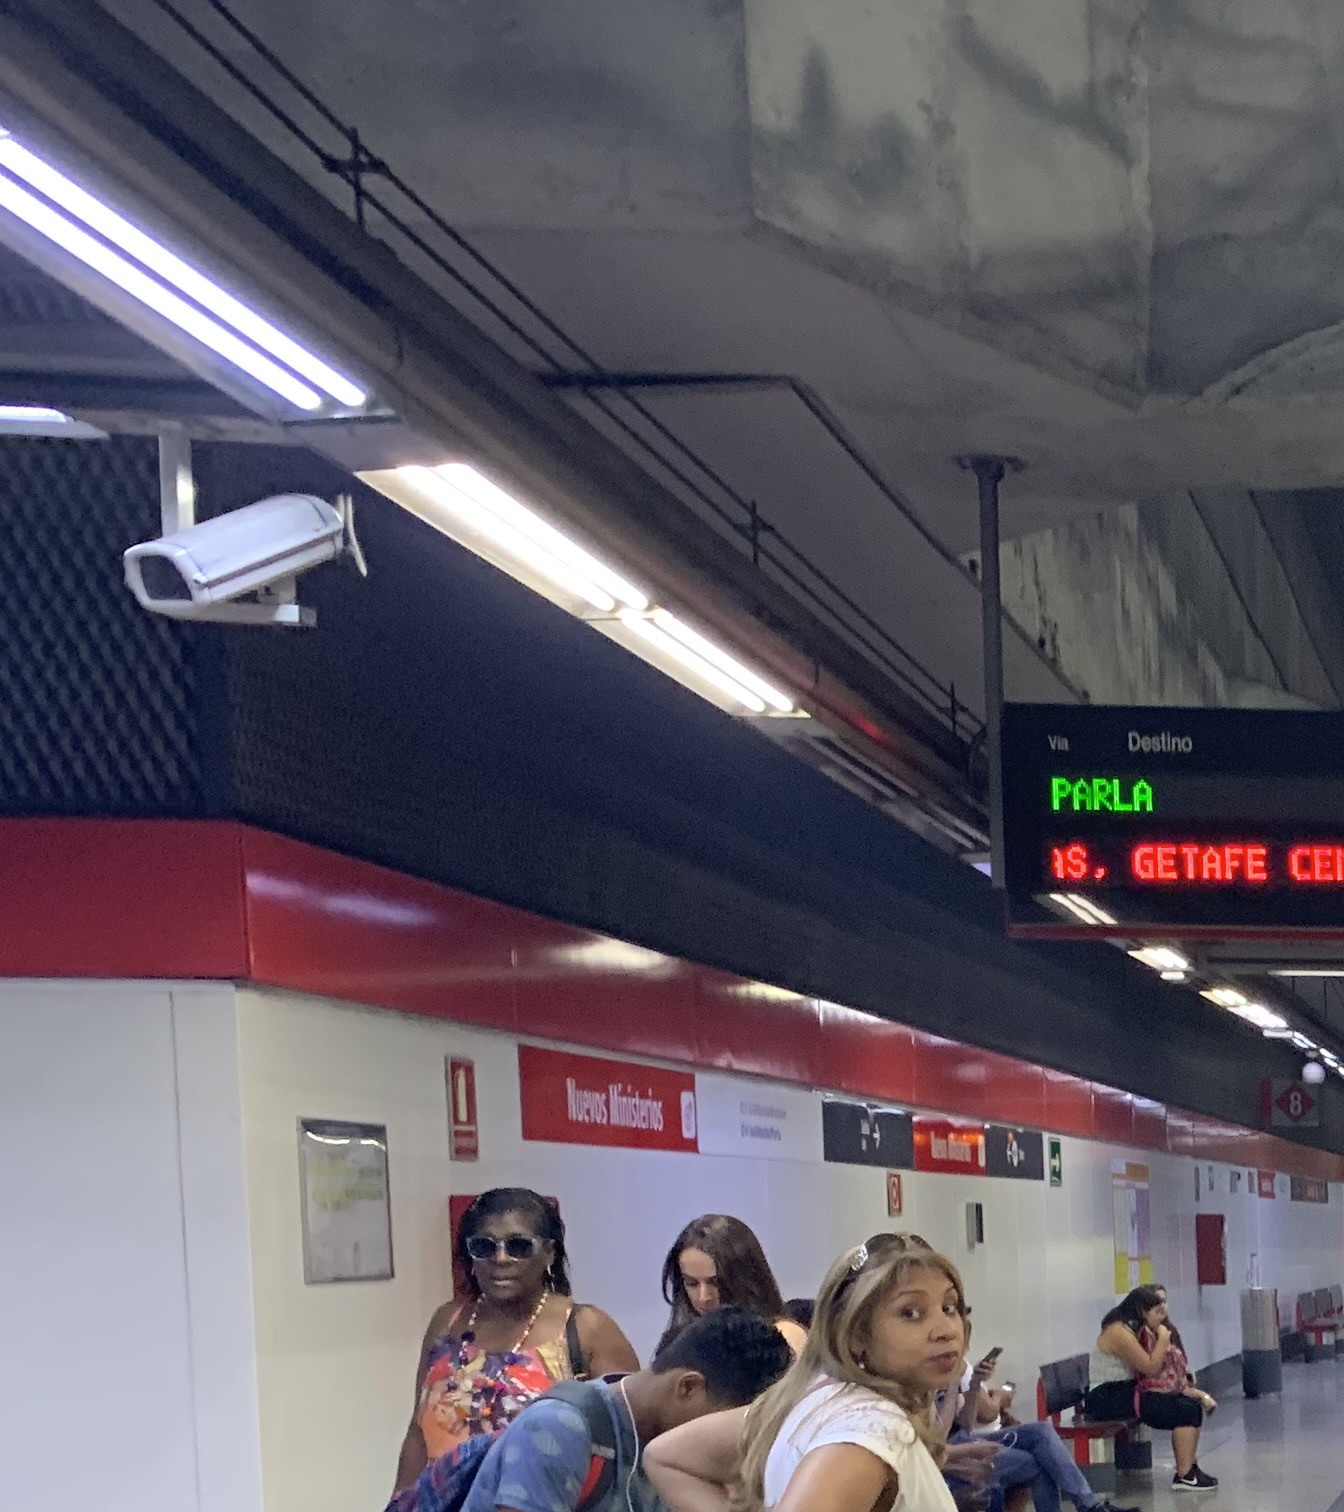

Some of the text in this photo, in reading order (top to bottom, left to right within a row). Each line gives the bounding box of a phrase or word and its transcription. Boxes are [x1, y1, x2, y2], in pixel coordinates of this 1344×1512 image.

[1127, 730, 1193, 753] Destino
[1051, 777, 1154, 812] PARLA
[1134, 844, 1269, 881] GETAFE
[566, 1076, 665, 1133] Nuevos Ministerios
[1289, 1091, 1302, 1115] 8
